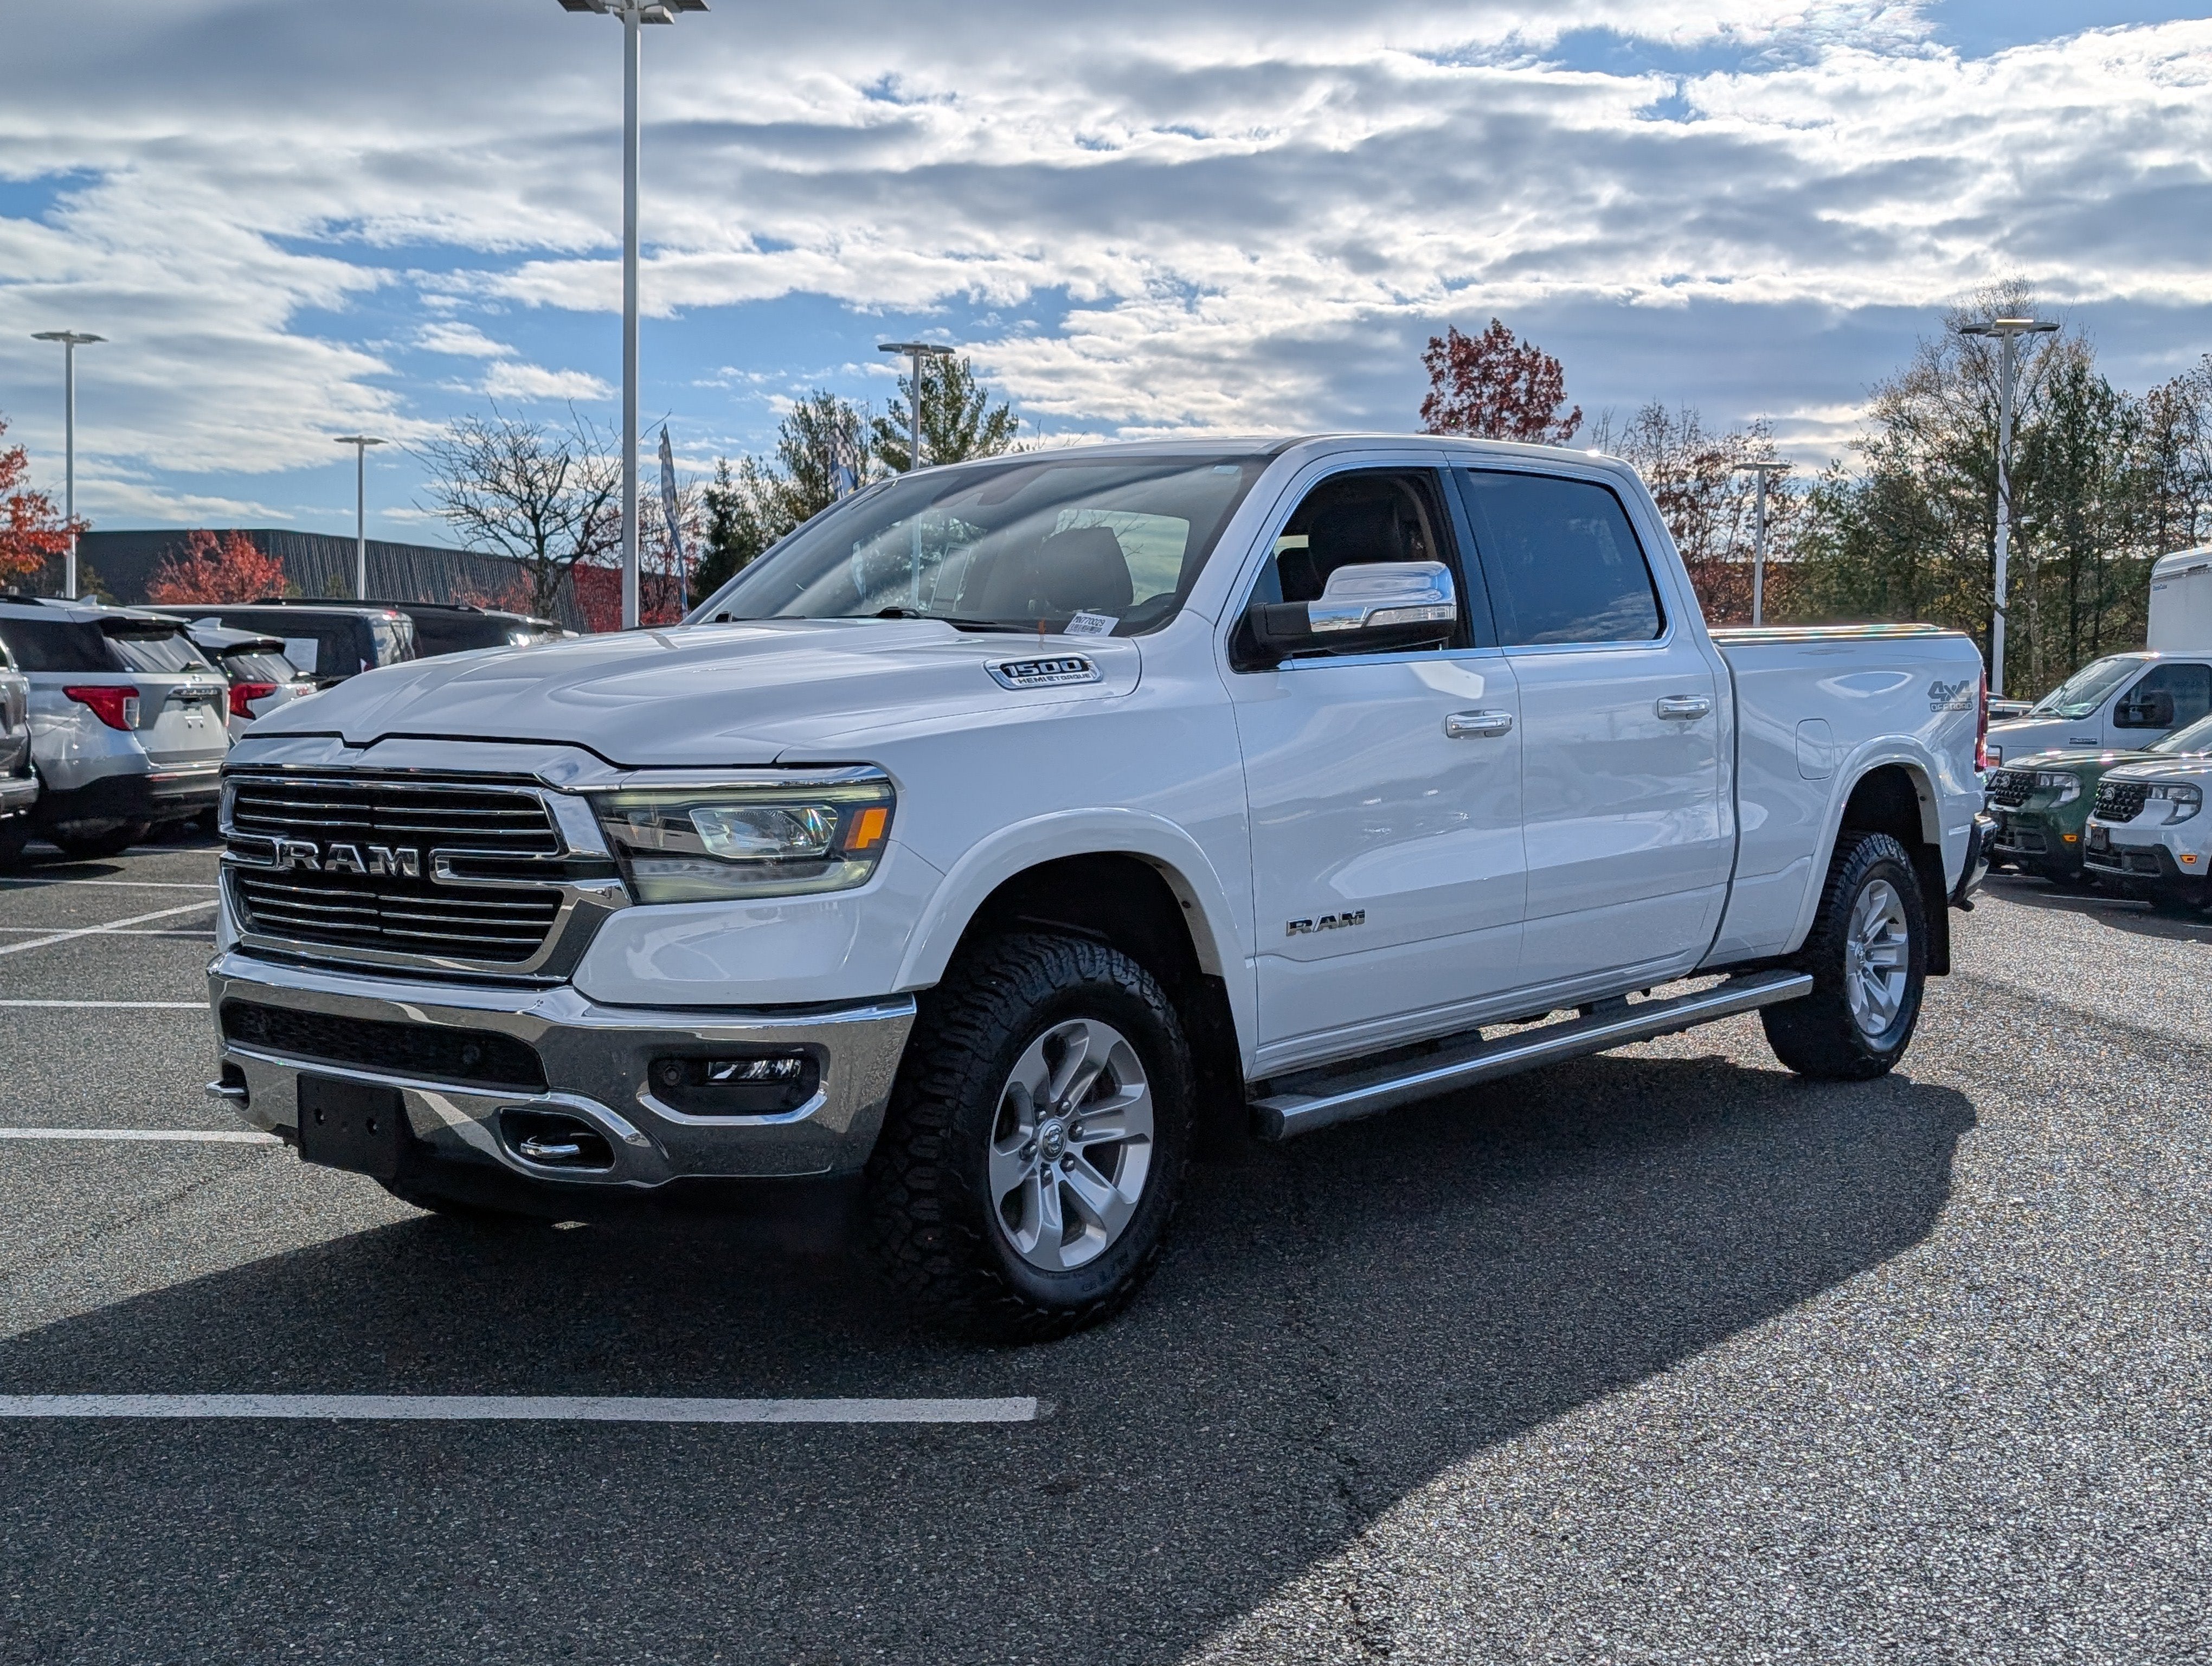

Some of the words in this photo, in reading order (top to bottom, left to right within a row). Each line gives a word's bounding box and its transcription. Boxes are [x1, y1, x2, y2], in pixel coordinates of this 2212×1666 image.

[1004, 659, 1082, 677] 1500
[275, 840, 420, 877] RAM
[1286, 909, 1365, 937] RAM
